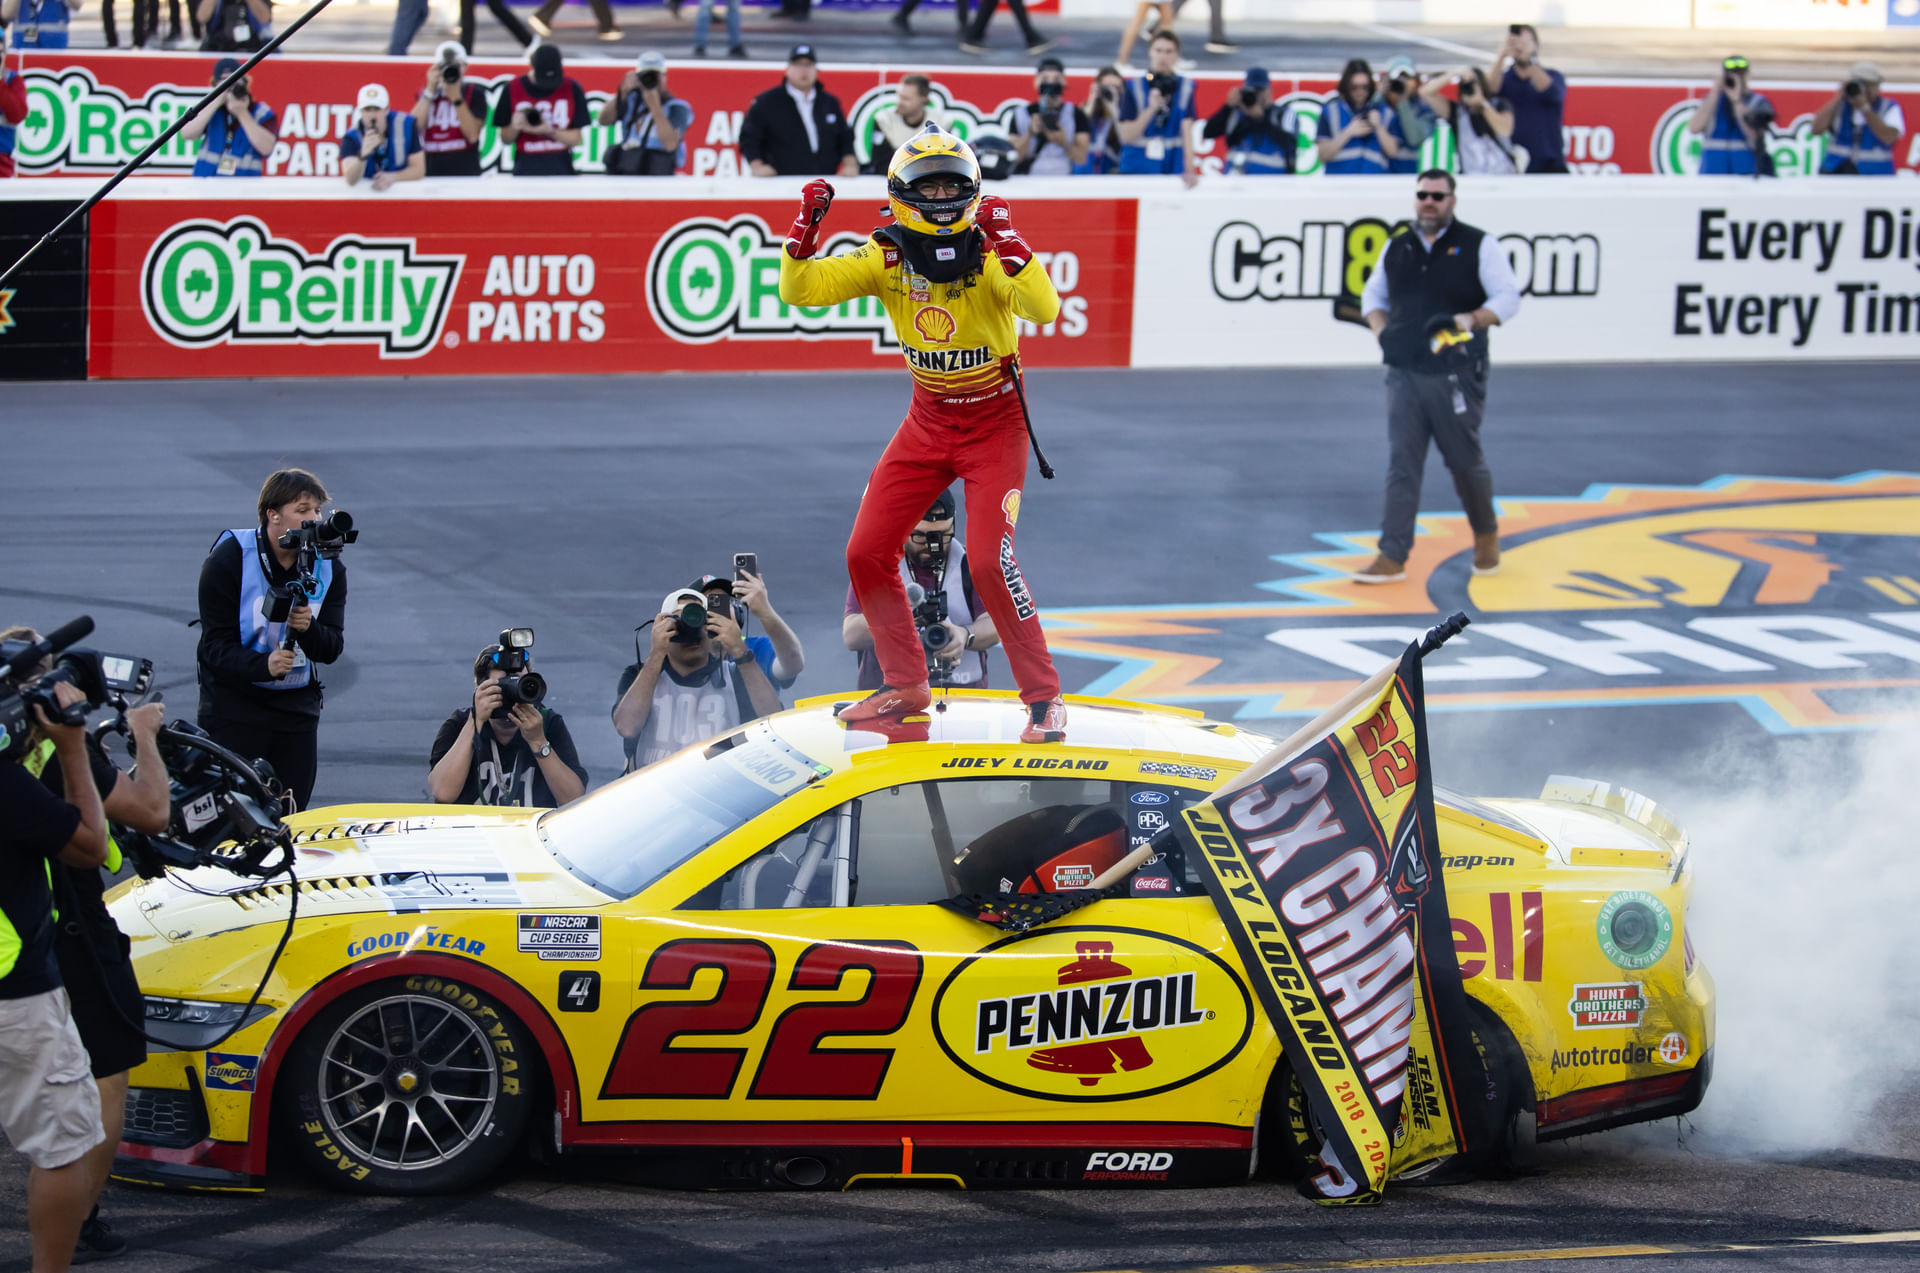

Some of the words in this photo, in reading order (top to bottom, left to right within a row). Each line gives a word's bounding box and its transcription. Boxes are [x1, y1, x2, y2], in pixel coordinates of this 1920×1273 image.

[266, 142, 342, 176] PAR
[1698, 208, 1843, 273] Every
[1863, 208, 1920, 272] Di
[161, 237, 435, 337] O'Reilly
[483, 255, 595, 297] AUTO
[467, 301, 606, 343] PARTS
[1674, 284, 1820, 347] Every
[901, 340, 994, 373] PENNZOIL
[653, 693, 727, 744] 103
[941, 757, 1007, 769] JOEY
[1012, 758, 1110, 771] LOGANO
[1352, 701, 1419, 798] 22
[1138, 793, 1162, 803] Ford
[1139, 812, 1162, 827] PPG
[1228, 762, 1346, 882] 3X
[1441, 854, 1515, 870] nap-on
[530, 933, 552, 943] CUP
[552, 933, 590, 944] SERIES
[544, 916, 589, 928] NASCAR
[1450, 891, 1543, 982] ell
[541, 951, 598, 959] CHAMPIONSHIP
[1183, 810, 1264, 908] JOEY
[1247, 920, 1346, 1071] LOGANO
[1335, 1081, 1365, 1121] 2018
[567, 977, 592, 1006] 4
[1574, 999, 1641, 1012] BROTHERS
[1589, 988, 1627, 1000] HUNT
[598, 937, 924, 1101] 22
[976, 971, 1207, 1055] PENNZOIL
[1588, 1010, 1627, 1022] PIZZA
[208, 1066, 255, 1079] SUNOCO
[1551, 1042, 1656, 1070] Autotrader
[1417, 1054, 1441, 1118] TEAM
[304, 1120, 372, 1181] EAGLE
[1086, 1152, 1174, 1171] FORD
[1082, 1171, 1169, 1181] PERFORMANCE
